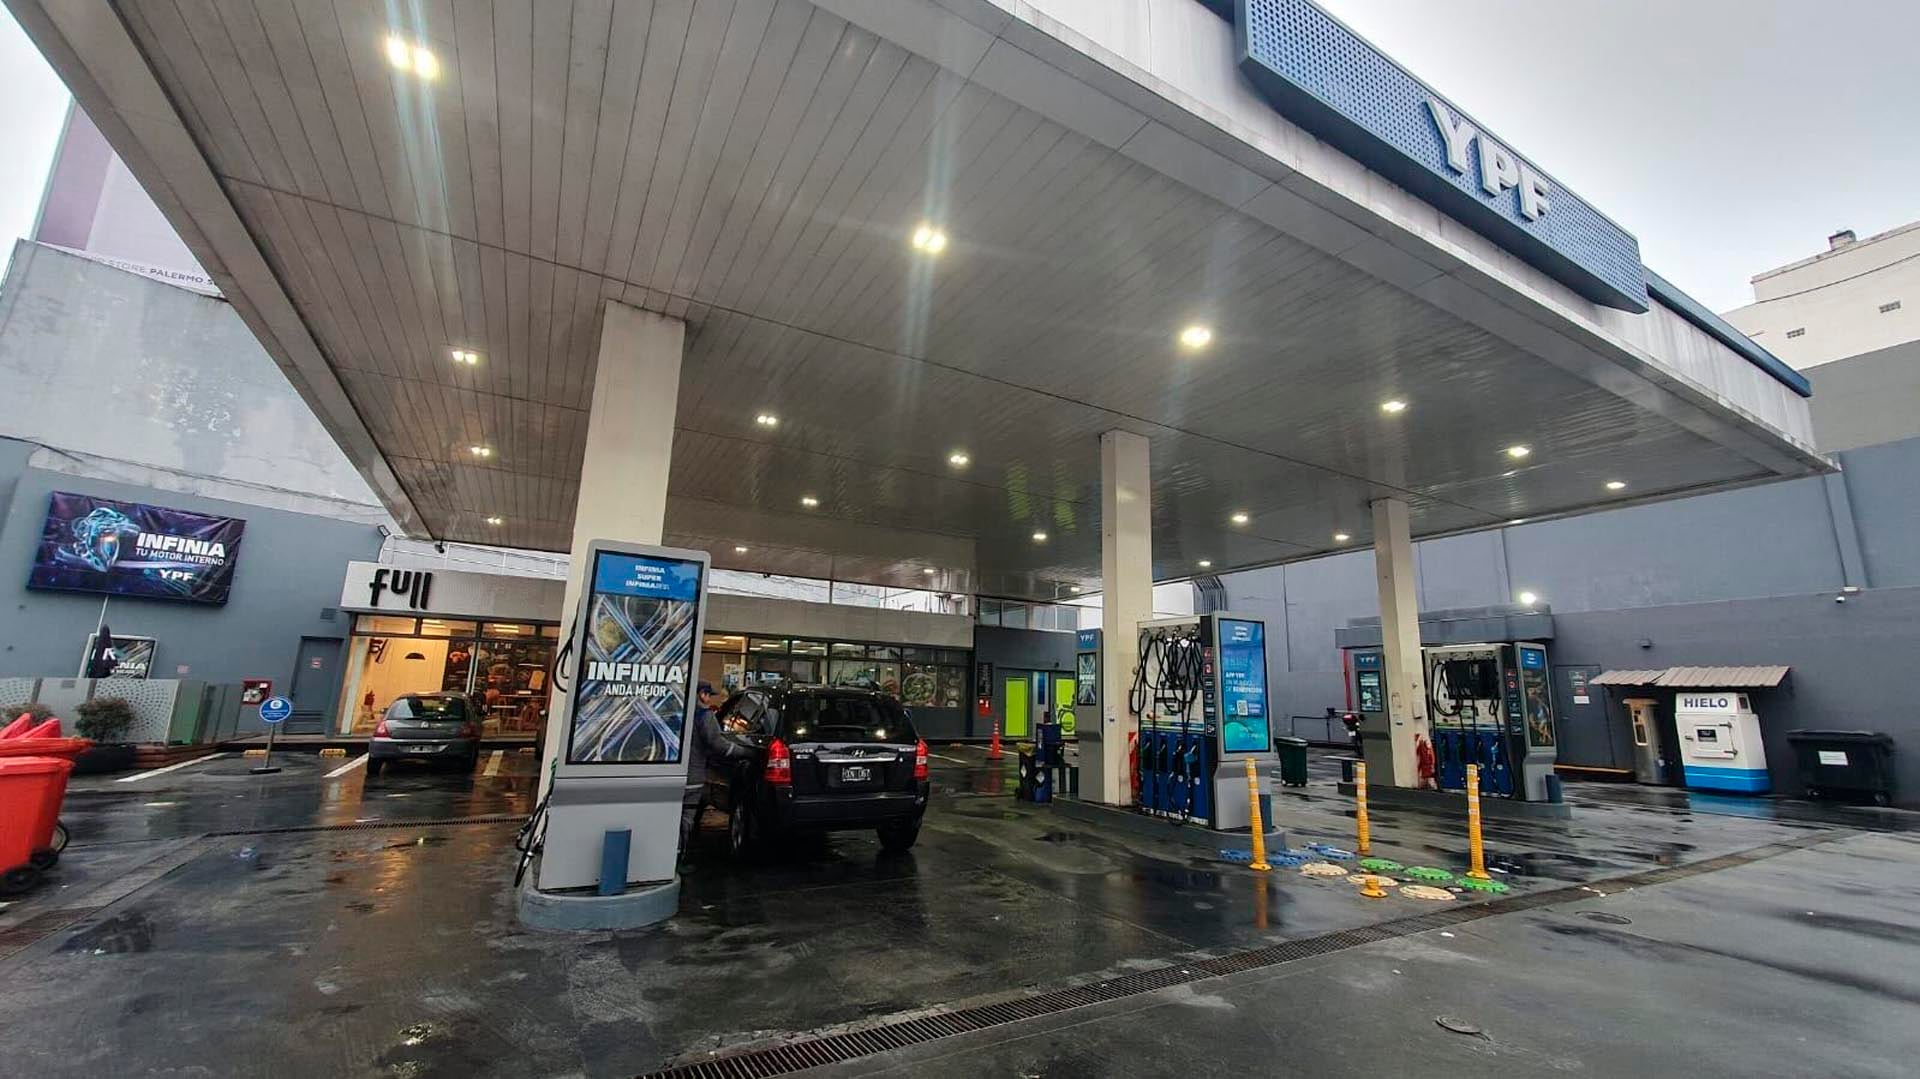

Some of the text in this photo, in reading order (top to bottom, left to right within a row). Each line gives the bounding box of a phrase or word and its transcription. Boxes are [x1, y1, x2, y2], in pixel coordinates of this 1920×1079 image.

[1425, 97, 1551, 221] YPF
[137, 532, 226, 558] INFINIA
[136, 548, 225, 566] TU MOTOR INTERNO
[160, 569, 194, 581] YPF
[369, 568, 433, 610] full
[587, 662, 684, 684] INFINIA
[605, 683, 667, 697] ANDA MEJOR
[1684, 698, 1728, 708] HIELO
